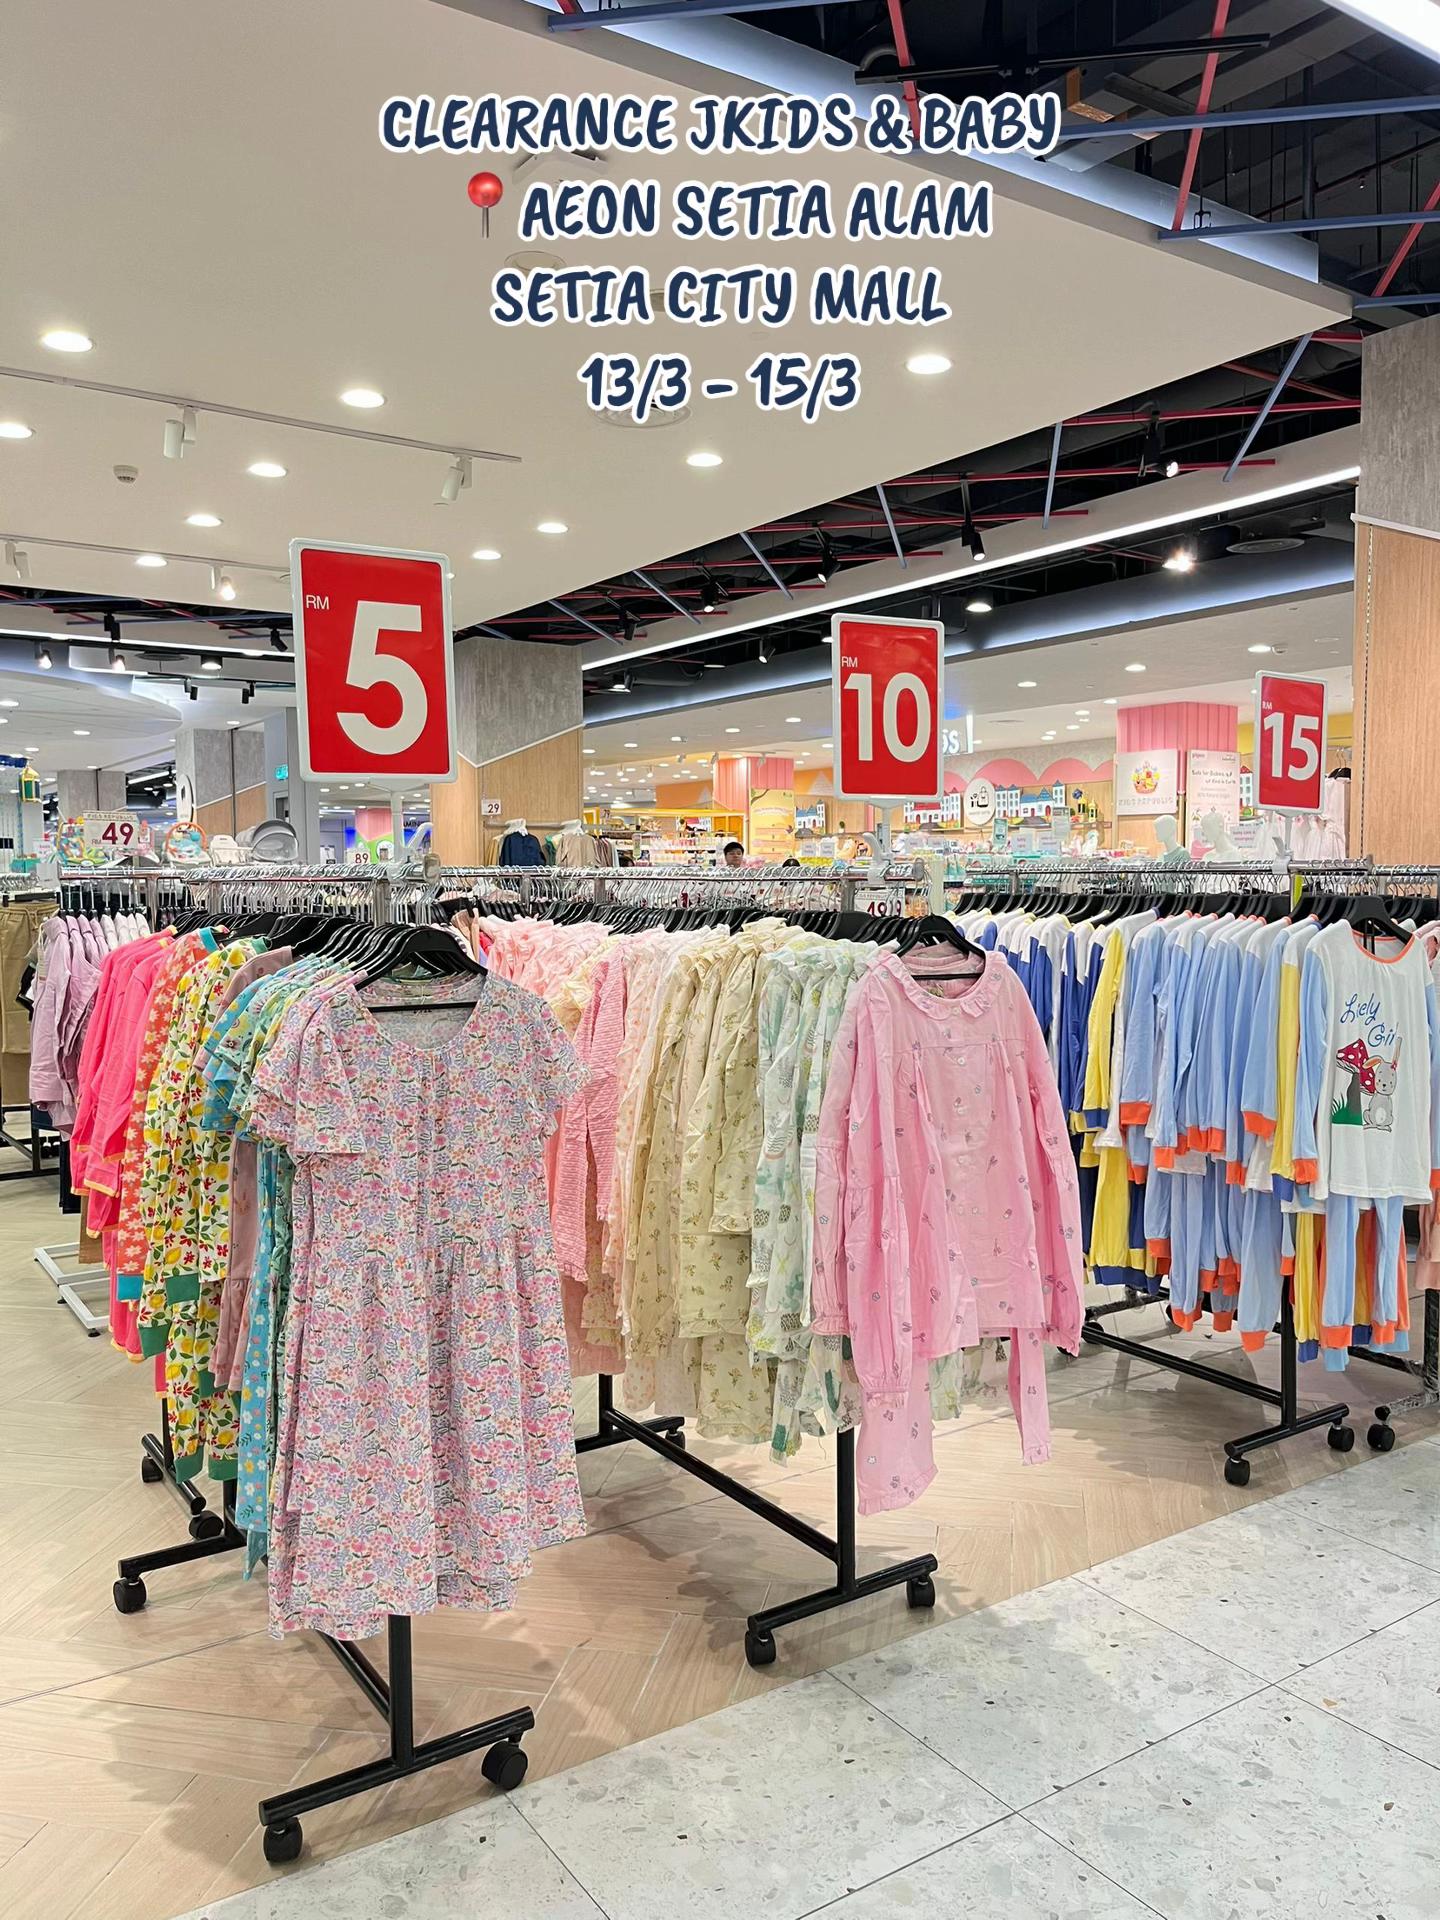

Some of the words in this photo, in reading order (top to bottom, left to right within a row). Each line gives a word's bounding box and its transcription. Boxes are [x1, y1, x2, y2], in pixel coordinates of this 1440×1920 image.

[841, 656, 858, 668] RM
[306, 595, 329, 610] RM
[336, 600, 428, 755] 5
[1262, 701, 1273, 711] RM
[843, 672, 931, 763] 10
[1263, 712, 1320, 781] 15
[487, 803, 500, 814] 29
[101, 822, 134, 846] 49
[355, 853, 369, 864] 89
